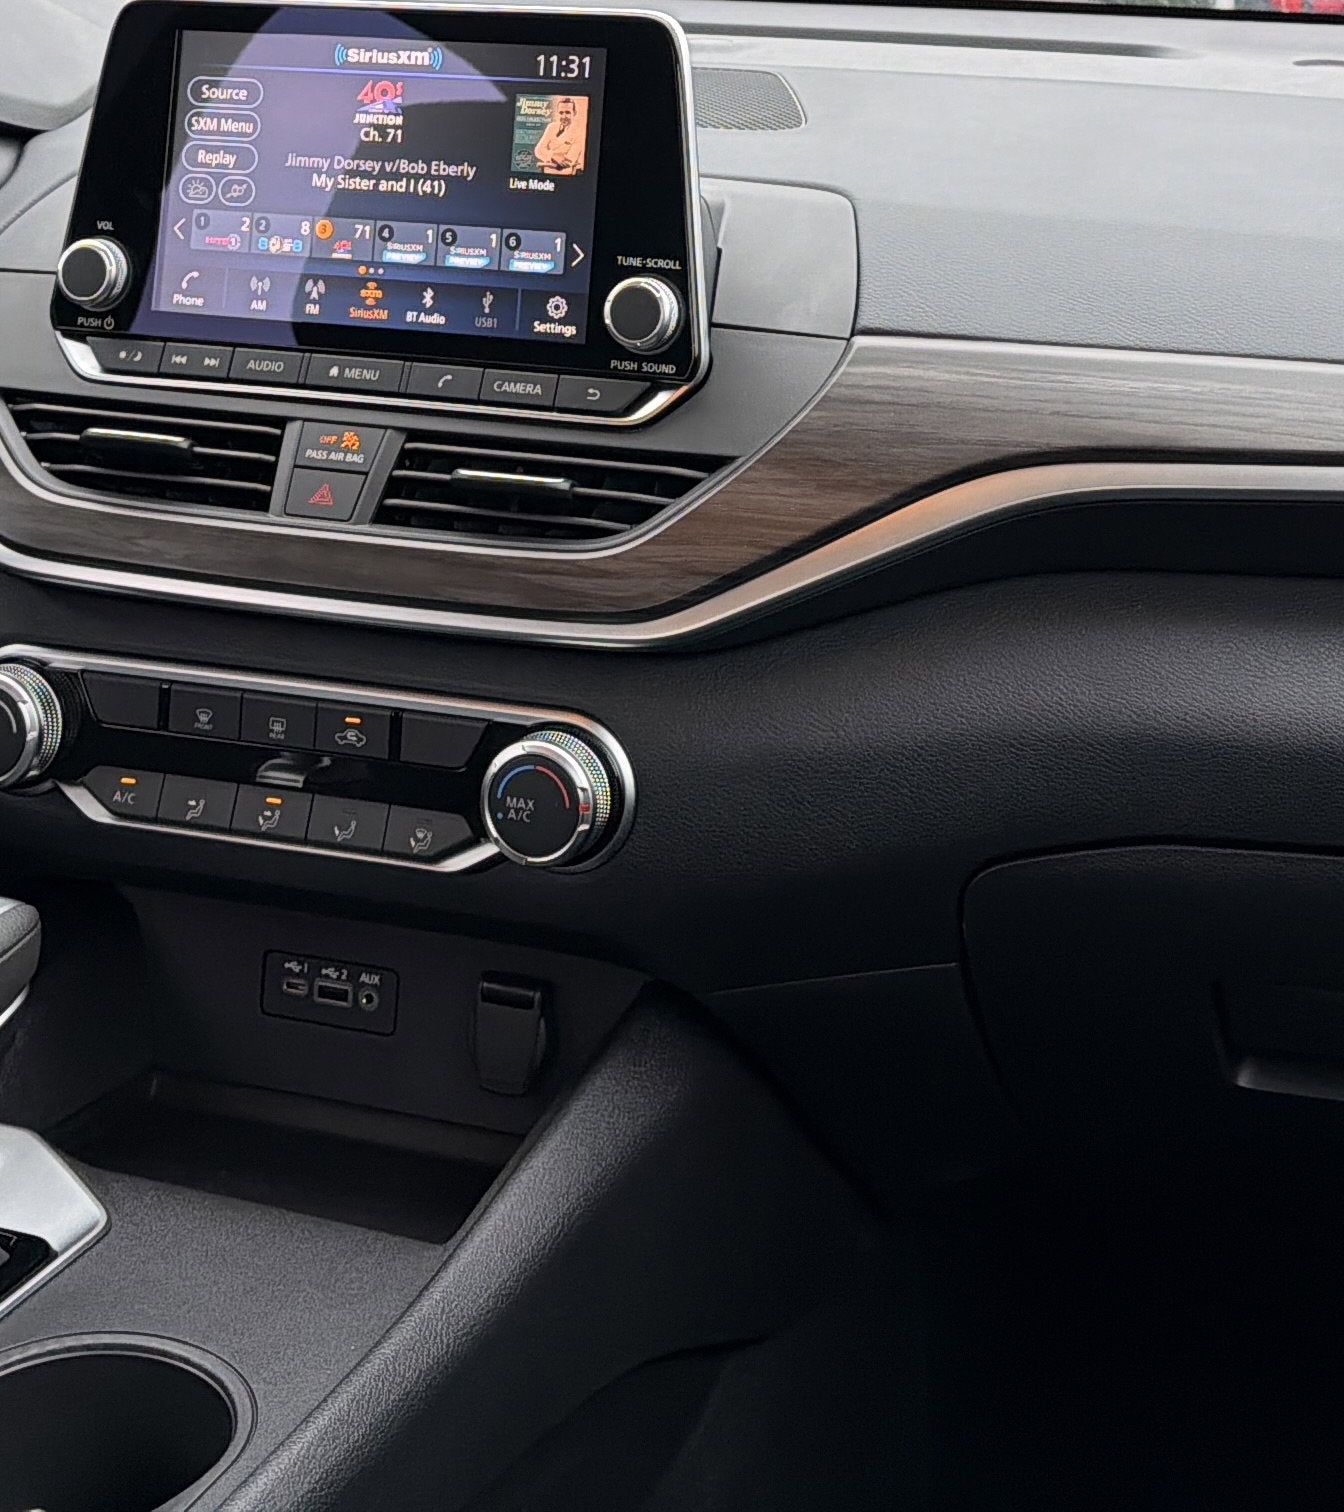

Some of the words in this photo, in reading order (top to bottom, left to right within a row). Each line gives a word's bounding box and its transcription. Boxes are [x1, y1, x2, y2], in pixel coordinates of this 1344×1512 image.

[536, 53, 592, 79] 11:31
[201, 84, 248, 100] Source
[191, 117, 217, 131] SXM
[220, 118, 254, 133] Menu
[353, 112, 404, 125] JUNCTION
[360, 127, 382, 142] Ch.
[386, 129, 403, 143] 71
[197, 149, 237, 168] Replay
[285, 153, 331, 172] Jimmy
[333, 156, 381, 175] Dorsey
[385, 159, 427, 174] v/Bob
[431, 161, 476, 180] Eberly
[311, 174, 334, 192] My
[337, 175, 376, 190] Sister
[379, 178, 406, 191] and
[418, 179, 446, 197] (41)
[509, 177, 528, 190] Live
[529, 179, 555, 192] Mode
[96, 220, 115, 231] VOL
[241, 216, 251, 232] 2
[300, 221, 311, 236] 8
[354, 224, 371, 239] 71
[77, 316, 102, 327] PUSH
[172, 294, 204, 307] Phone
[250, 299, 266, 311] AM
[305, 304, 320, 315] FM
[349, 307, 389, 320] SiriusXM
[406, 311, 418, 323] BT
[418, 313, 446, 325] Audio
[474, 317, 498, 329] USB1
[533, 321, 577, 337] Settings
[246, 359, 284, 373] AUDIO
[610, 359, 638, 371] PUSH
[641, 361, 677, 374] SOUND
[343, 367, 380, 381] MENU
[493, 380, 543, 396] CAMERA
[319, 434, 338, 444] OFF
[304, 449, 327, 459] PASS
[329, 451, 344, 461] AIR
[345, 453, 365, 463] BAG
[112, 791, 137, 805] A/C
[505, 796, 535, 811] MAX
[507, 809, 531, 823] A/C
[359, 972, 380, 986] AUX
